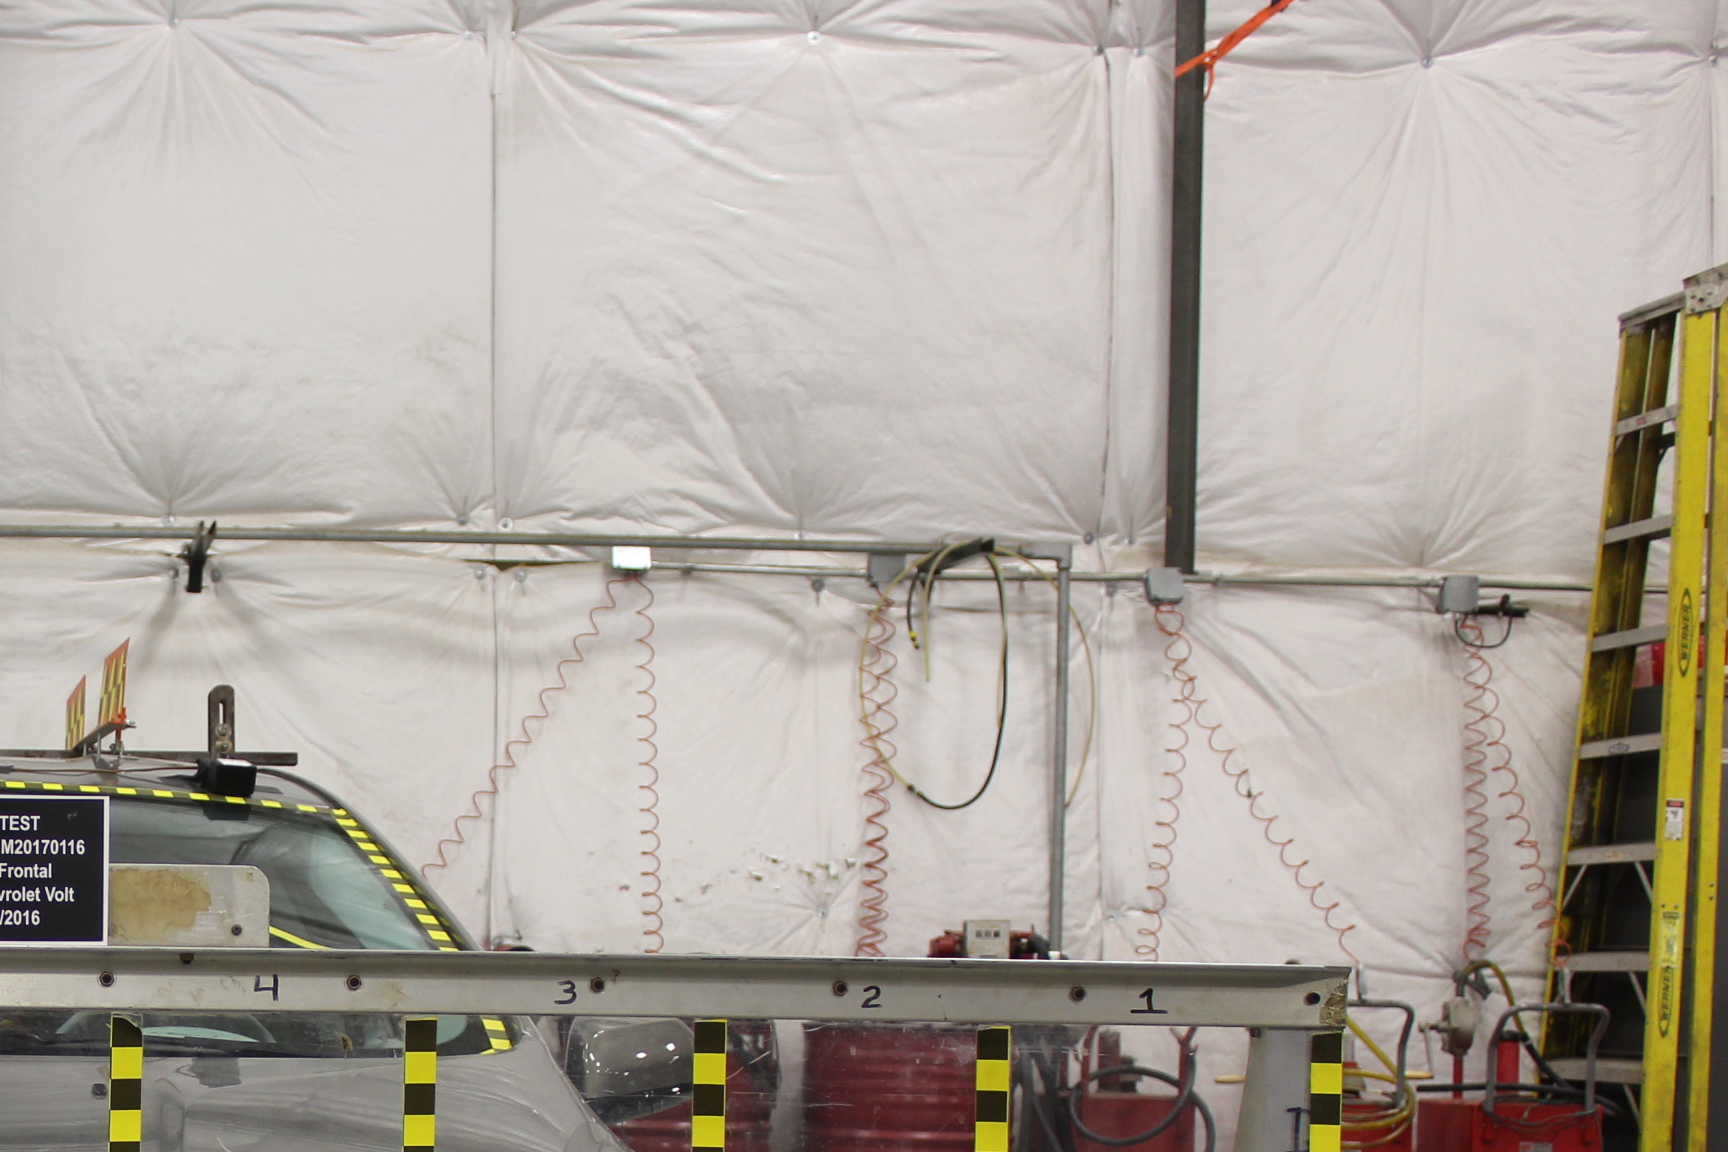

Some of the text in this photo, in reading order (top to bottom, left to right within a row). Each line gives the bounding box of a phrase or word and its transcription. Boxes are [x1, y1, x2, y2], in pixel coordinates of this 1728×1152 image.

[45, 886, 75, 902] Volt
[253, 974, 279, 1001] 4
[554, 980, 577, 1005] 3
[861, 985, 884, 1009] 2
[1130, 988, 1168, 1014] 1
